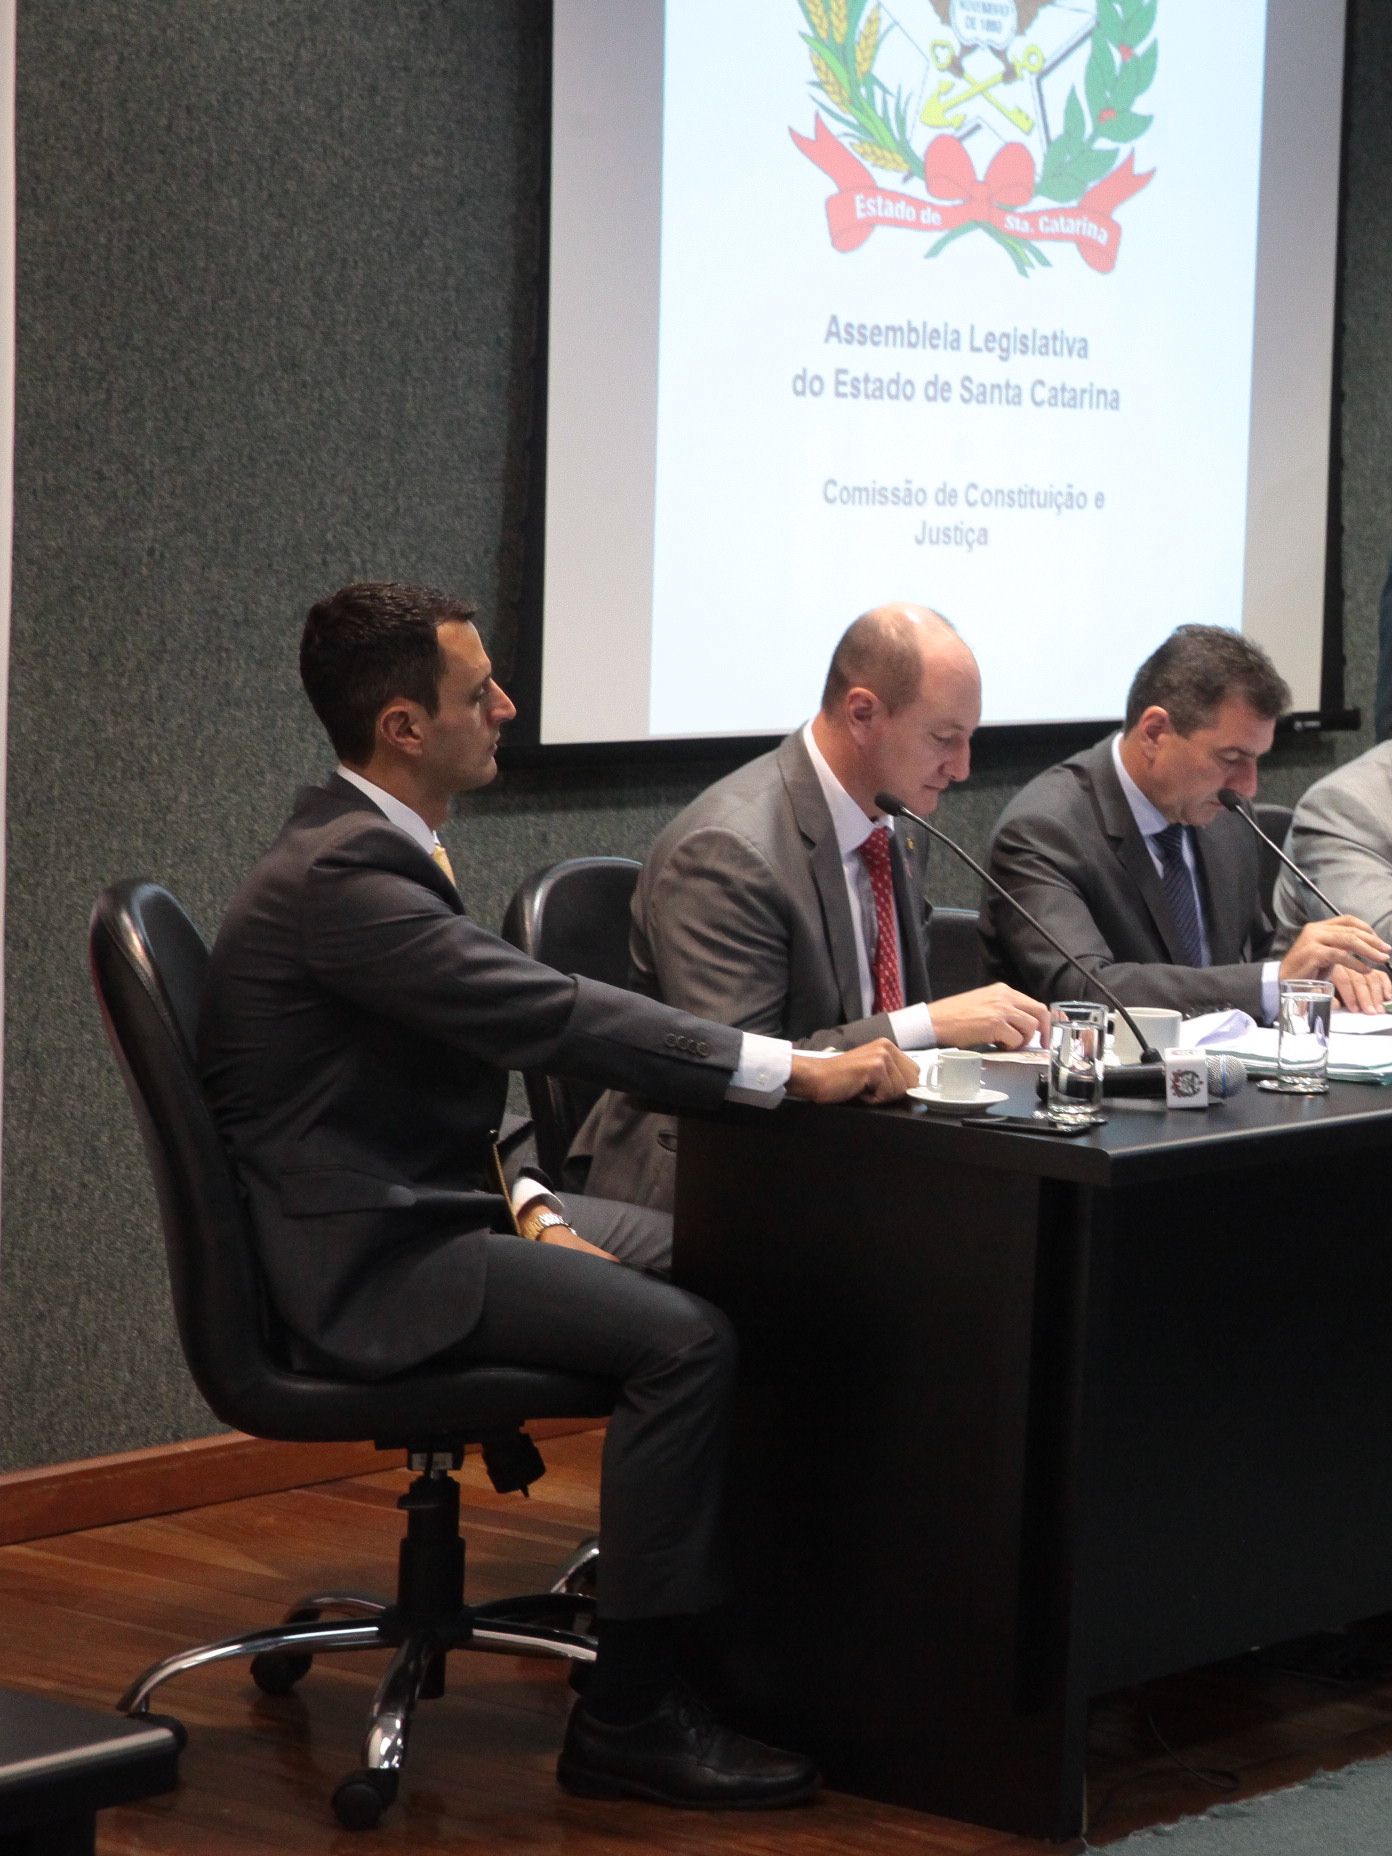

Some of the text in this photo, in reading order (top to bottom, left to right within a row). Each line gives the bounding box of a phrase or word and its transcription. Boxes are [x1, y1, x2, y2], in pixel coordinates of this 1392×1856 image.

[854, 193, 943, 226] Estado de
[1004, 214, 1109, 246] Sta. Catarina
[824, 313, 1089, 363] Assembleia Legislativa
[792, 367, 1121, 411] do Estado de Santa Catarina
[823, 478, 1106, 515] Comissão de Constituição e
[914, 519, 990, 553] Justiça
